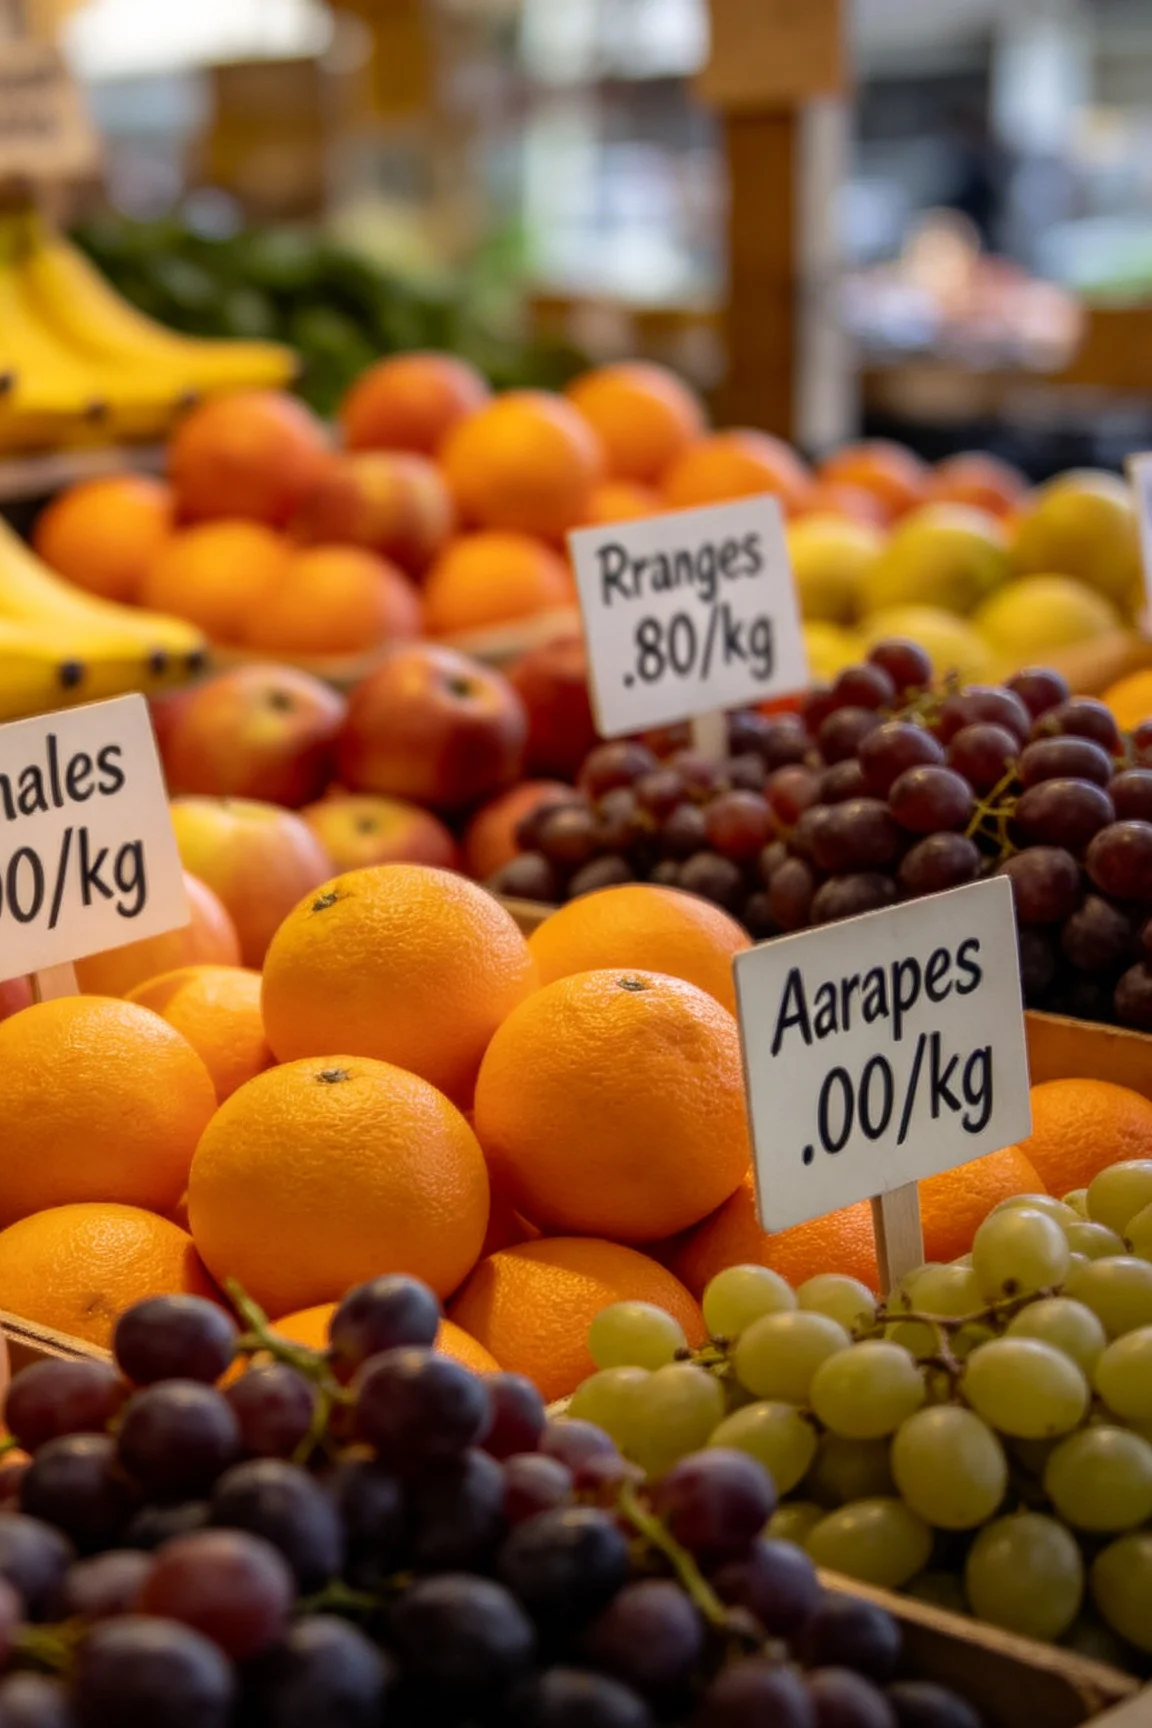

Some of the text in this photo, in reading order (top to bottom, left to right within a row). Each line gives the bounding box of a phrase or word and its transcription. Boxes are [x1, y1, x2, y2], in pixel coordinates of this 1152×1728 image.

[596, 533, 763, 605] Rranges
[623, 602, 774, 687] .80/kg
[771, 937, 983, 1057] Aarapes
[802, 1031, 994, 1166] .00/kg
